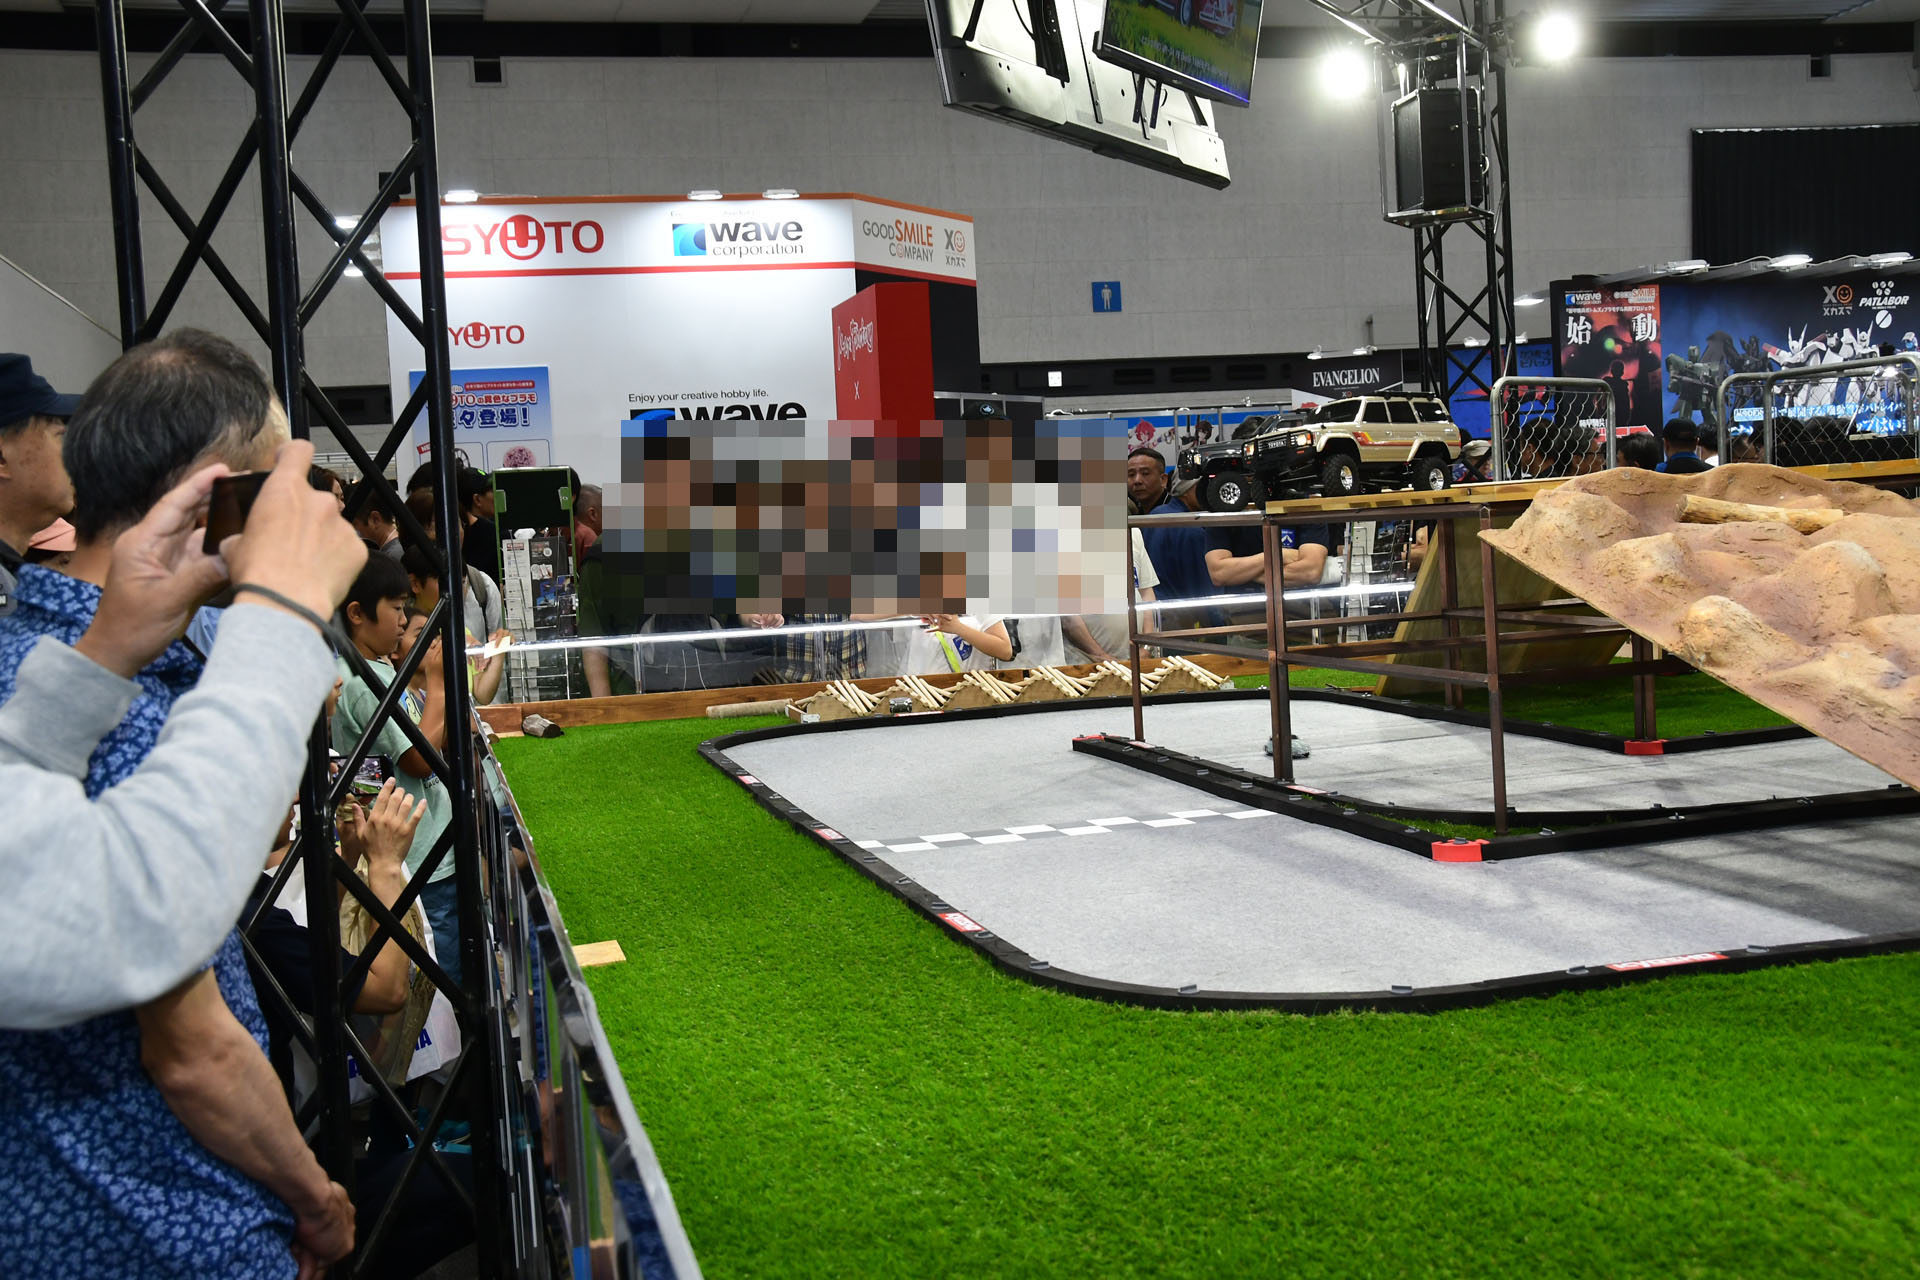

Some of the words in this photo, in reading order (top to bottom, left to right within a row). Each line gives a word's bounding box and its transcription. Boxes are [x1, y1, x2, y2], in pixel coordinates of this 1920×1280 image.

[709, 220, 803, 242] wave
[862, 220, 895, 240] GOOD
[895, 218, 933, 247] SMILE
[712, 243, 804, 258] corporation
[889, 242, 934, 263] COMPANY
[1575, 292, 1602, 301] wave
[1858, 295, 1910, 307] PATLABOR
[447, 321, 525, 348] YUTO
[1565, 315, 1592, 345] 始
[1631, 312, 1657, 342] 動
[1312, 368, 1380, 388] EVANGELION
[628, 394, 655, 404] Enjoy
[657, 393, 679, 403] your
[681, 391, 719, 400] creative
[720, 390, 751, 400] hobby
[753, 389, 769, 398] life.
[679, 402, 807, 421] wave
